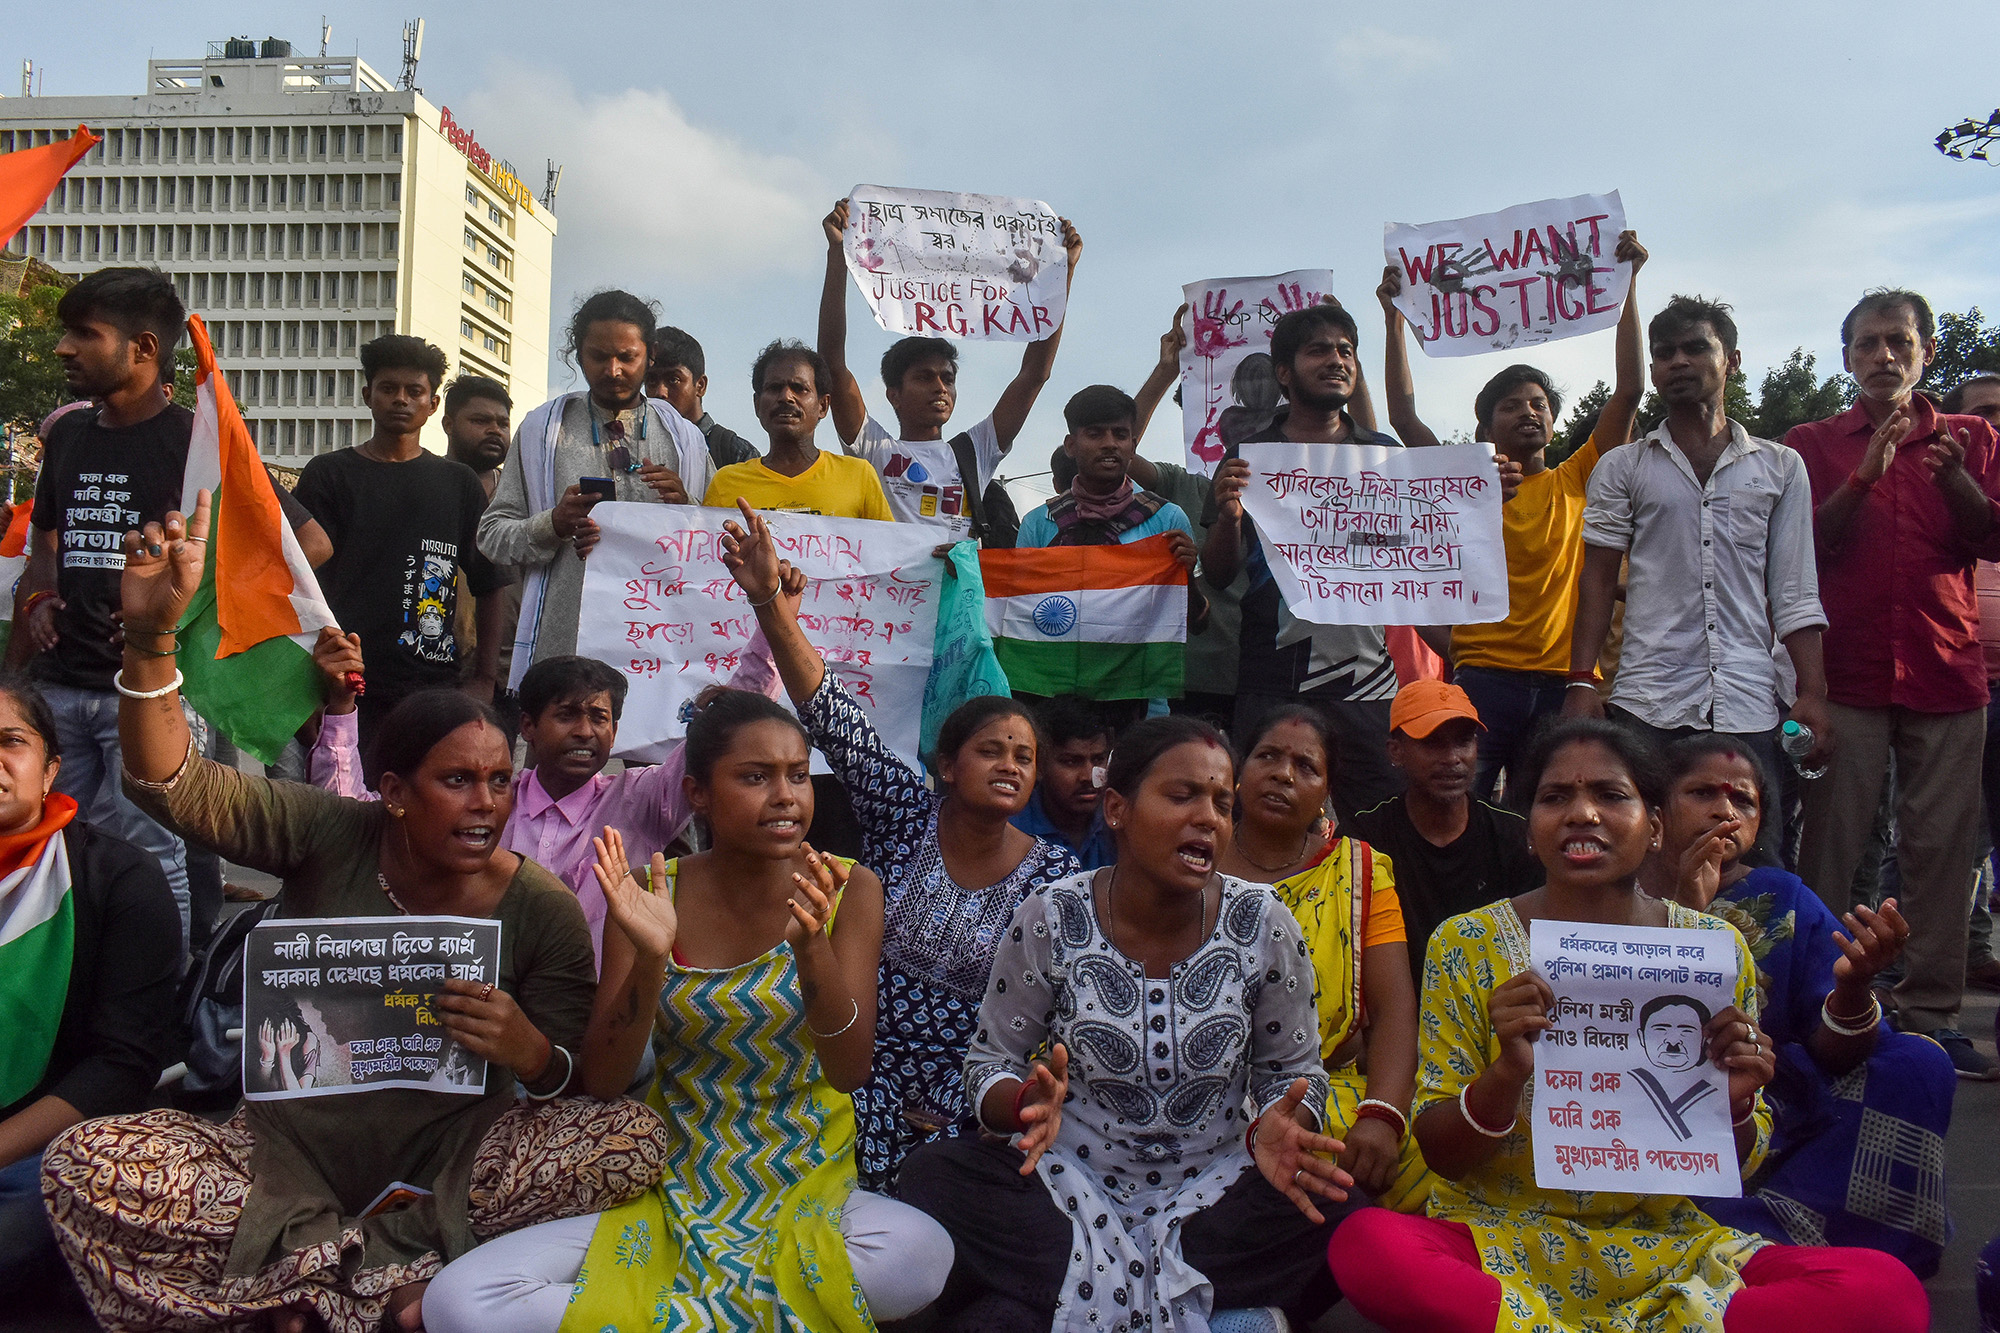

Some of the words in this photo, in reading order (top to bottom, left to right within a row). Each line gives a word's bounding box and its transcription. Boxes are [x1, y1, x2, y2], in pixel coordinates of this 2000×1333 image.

[440, 106, 491, 174] Peerless
[496, 163, 535, 216] HOTEL
[859, 201, 906, 226] ছাত্র
[911, 205, 985, 230] সমাজের
[1399, 242, 1463, 286] WE
[1483, 214, 1609, 272] WANT
[868, 269, 961, 301] JUSTICE
[970, 278, 1020, 305] FOR
[983, 303, 1054, 335] KAR
[1417, 267, 1619, 342] JUSTICE
[79, 473, 103, 483] দফা
[105, 474, 129, 484] এক
[1260, 468, 1354, 500] ব্যারিকেড
[1408, 475, 1488, 504] মানুষকে
[74, 486, 101, 501] দাবি
[104, 490, 131, 502] এক
[1300, 495, 1402, 536] আটকানো
[63, 529, 128, 550] পদত্যা
[421, 538, 458, 557] NARUTO
[273, 933, 311, 960] নারী
[315, 933, 388, 960] নিরাপত্তা
[392, 931, 434, 956] দিতে
[1559, 932, 1618, 956] ধর্ষকদের
[1622, 941, 1671, 960] আড়াল
[1676, 944, 1705, 962] করে
[262, 967, 320, 989] সরকার
[326, 965, 383, 988] দেখছে
[388, 955, 445, 983] ধর্ষকের
[1544, 956, 1587, 981] পুলিশ
[1592, 961, 1633, 981] প্রমাণ
[1638, 964, 1689, 984] লোপাট
[1694, 971, 1723, 988] করে
[384, 988, 419, 1008] ধর্ষক
[1600, 998, 1634, 1023] মন্ত্রী
[349, 1040, 374, 1054] দফা
[401, 1033, 423, 1052] দাবি
[424, 1037, 442, 1053] এক
[1545, 1028, 1578, 1047] নাও
[1583, 1025, 1629, 1050] বিদায়
[350, 1052, 402, 1080] মুখ্যমন্ত্রীর
[1544, 1069, 1582, 1092] দফা
[1589, 1071, 1621, 1093] এক
[1548, 1100, 1583, 1129] দাবি
[1590, 1109, 1621, 1131] এক
[1554, 1138, 1640, 1177] মুখ্যমন্ত্রীর
[1646, 1150, 1720, 1176] পদত্যাগ
